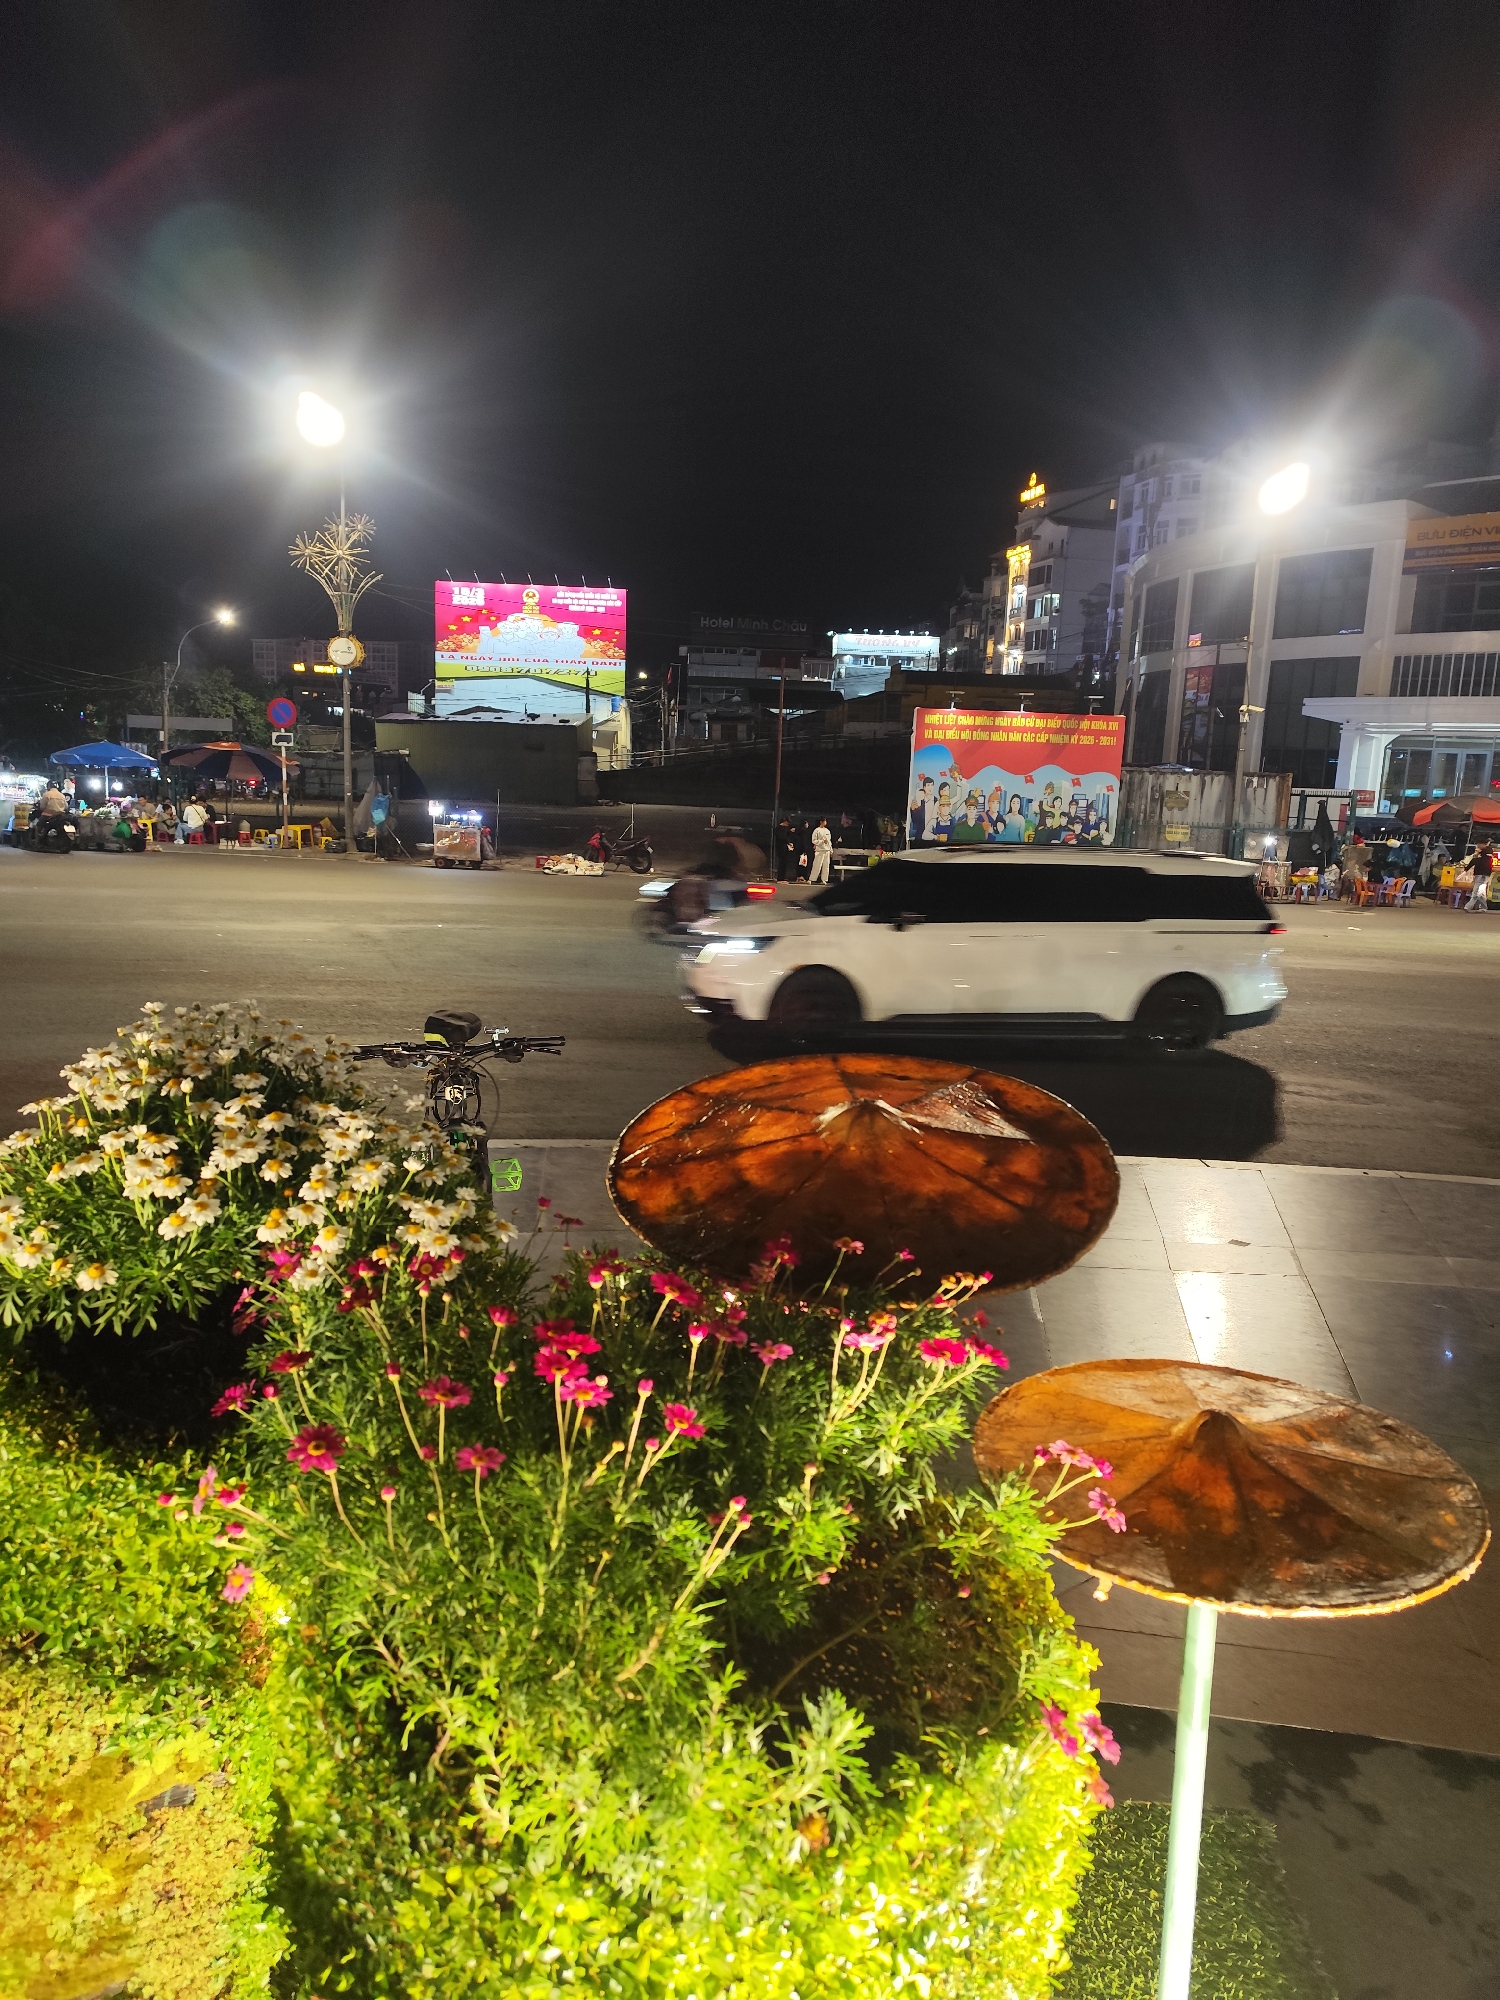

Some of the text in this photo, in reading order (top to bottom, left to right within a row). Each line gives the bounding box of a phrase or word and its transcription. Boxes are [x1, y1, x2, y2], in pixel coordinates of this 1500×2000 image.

[1449, 525, 1482, 539] ĐIỆN
[700, 616, 733, 629] Hotel
[737, 617, 769, 630] Minh
[924, 713, 943, 726] NHIỆT
[944, 713, 957, 726] LIỆT
[957, 714, 975, 726] CHÀO
[995, 715, 1012, 727] NGÀY
[1035, 718, 1046, 730] ĐẠI
[1047, 716, 1061, 729] BIỂU
[1062, 717, 1079, 729] QUỐC
[1079, 718, 1091, 731] HỘI
[1091, 719, 1107, 731] KHÓA
[1108, 721, 1119, 731] XVI
[924, 728, 933, 739] VÀ
[934, 729, 945, 741] ĐẠI
[946, 727, 960, 740] BIỂU
[961, 729, 972, 742] HỘI
[973, 728, 990, 741] ĐỒNG
[991, 730, 1008, 742] NHÂN
[1008, 731, 1022, 742] DÂN
[1022, 731, 1035, 743] CÁC
[1036, 730, 1049, 743] CẤP
[1049, 733, 1070, 745] NHIỆM
[1070, 733, 1079, 744] KỲ
[1079, 735, 1095, 745] 2026
[1099, 736, 1117, 746] 2031!
